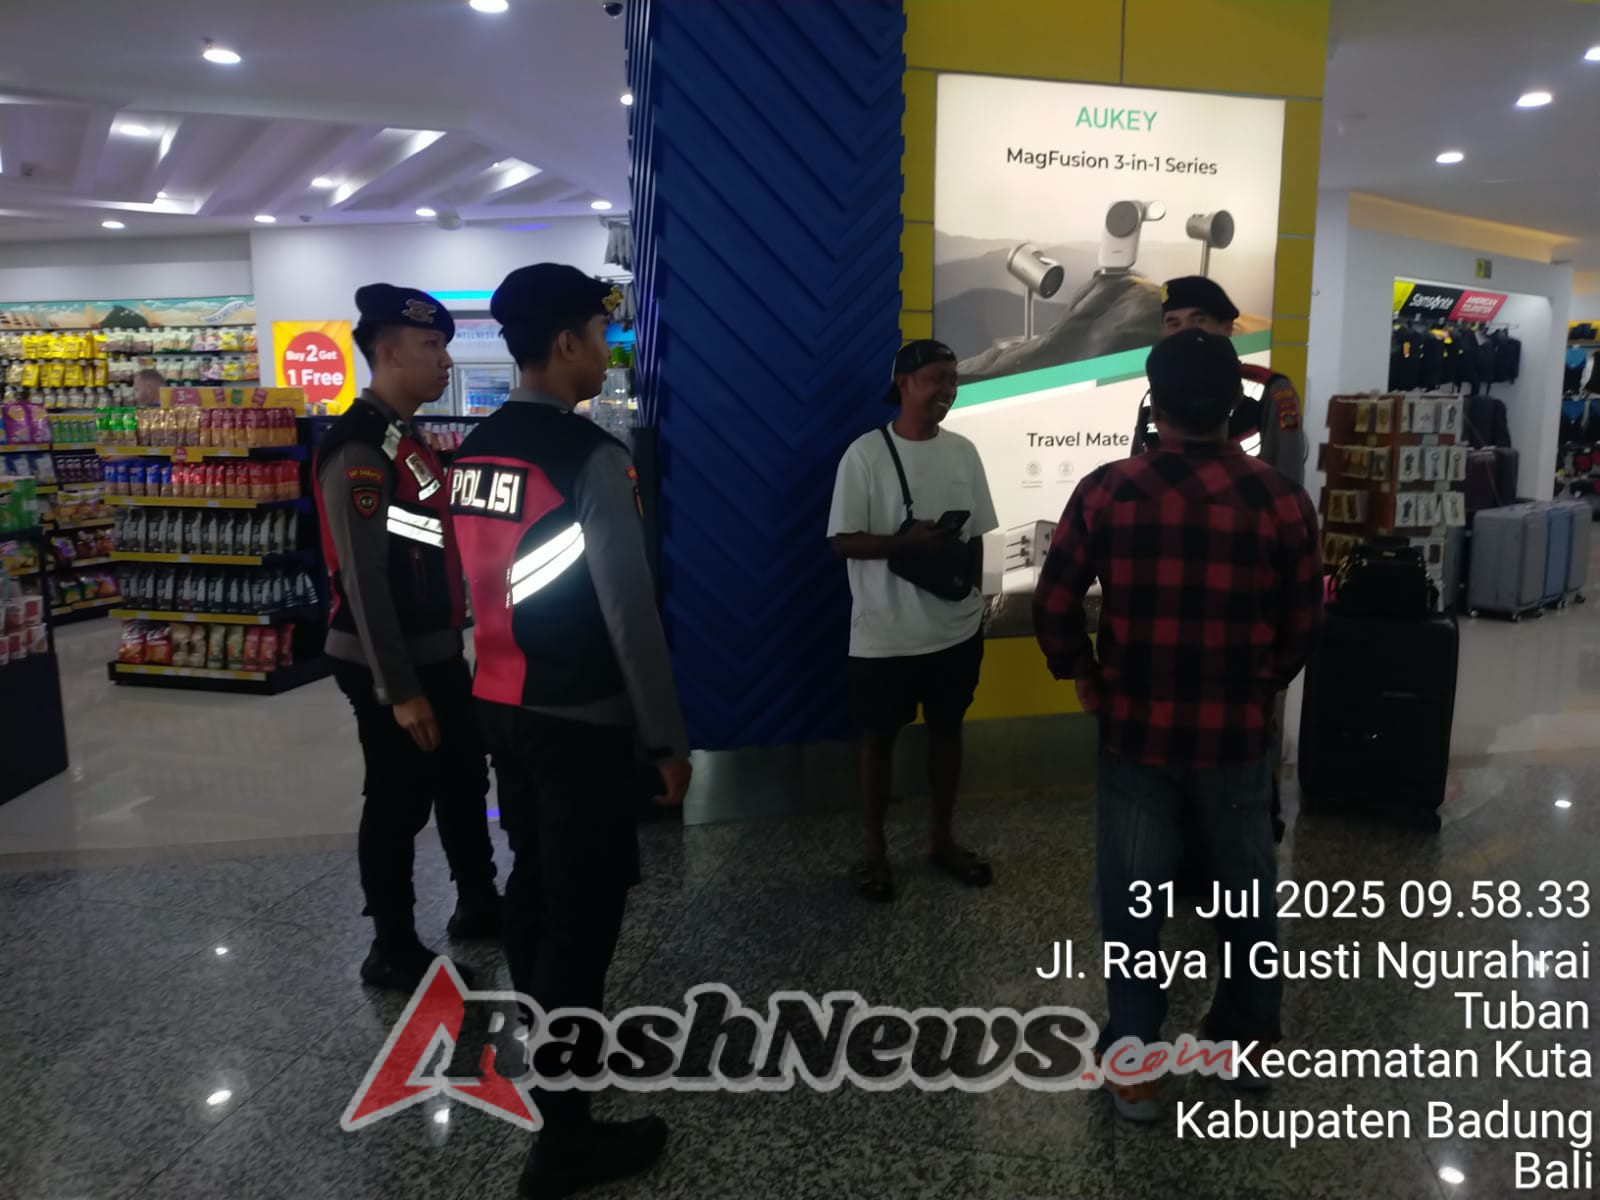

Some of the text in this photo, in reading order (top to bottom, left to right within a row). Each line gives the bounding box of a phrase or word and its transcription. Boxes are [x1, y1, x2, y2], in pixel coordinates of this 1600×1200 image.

[1075, 106, 1158, 132] AUKEY
[1006, 147, 1219, 176] MagFusion 3-in-1 Series
[286, 344, 338, 362] Buy 2 Get
[287, 368, 344, 386] 1 Free
[1027, 432, 1130, 448] Travel Mate
[450, 468, 521, 514] POLISI
